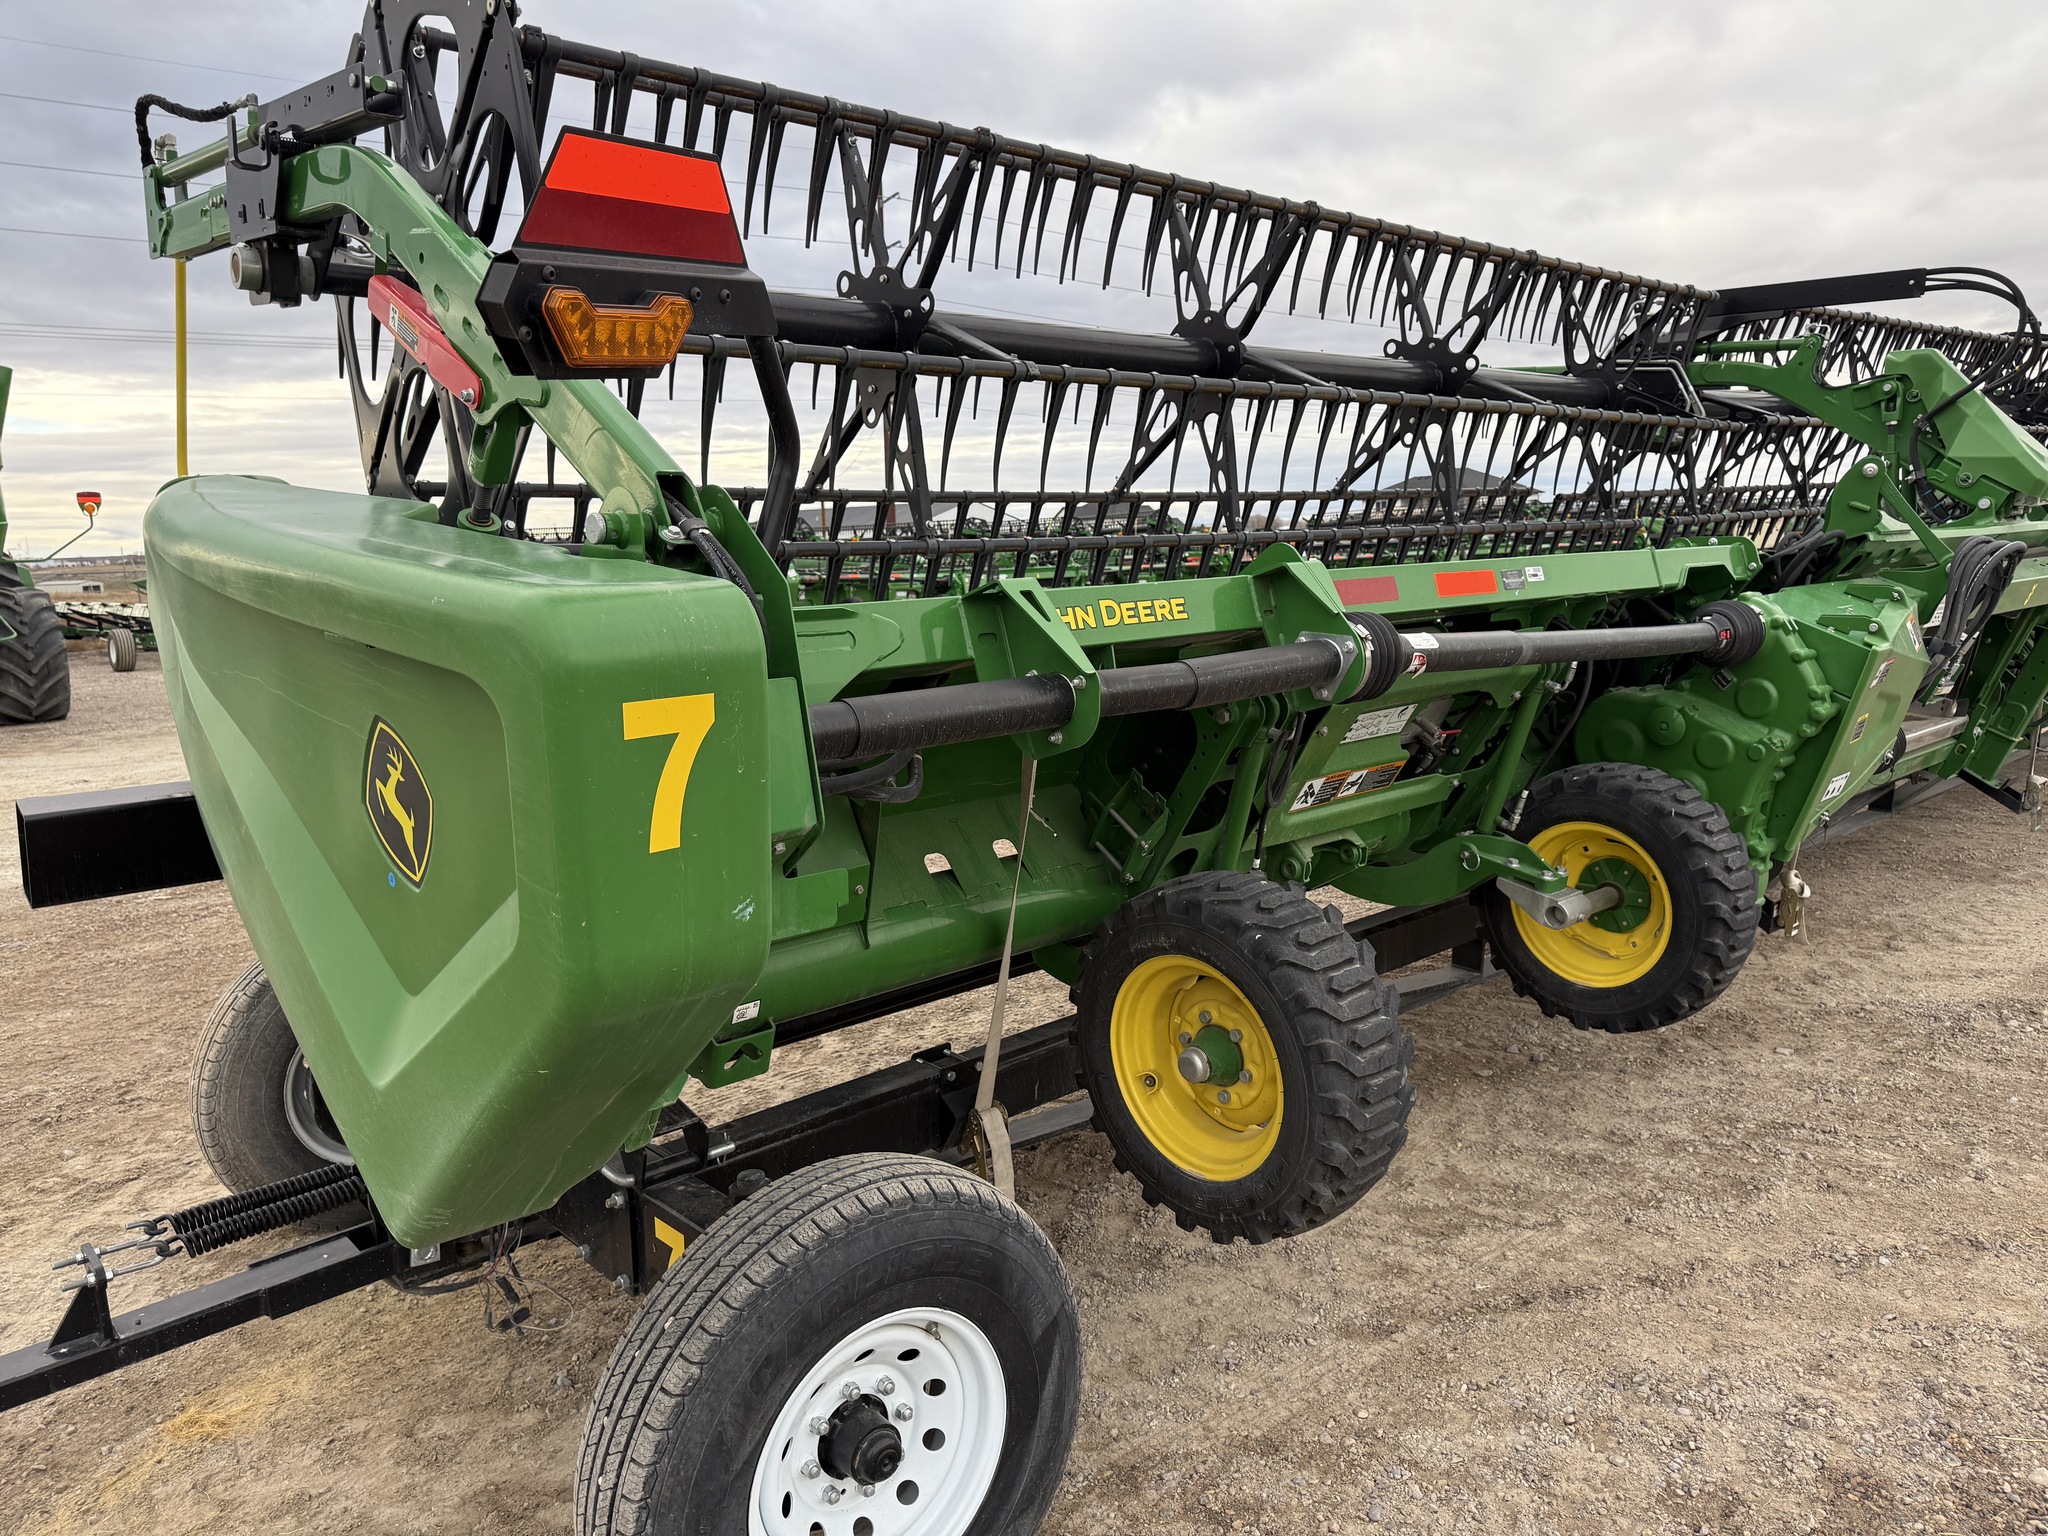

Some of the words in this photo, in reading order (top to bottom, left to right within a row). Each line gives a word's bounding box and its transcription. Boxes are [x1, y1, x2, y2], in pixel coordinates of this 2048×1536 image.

[303, 95, 308, 107] 2
[326, 85, 331, 98] 3
[1056, 604, 1097, 631] HN
[1098, 597, 1189, 628] DEERE
[622, 692, 716, 854] 7
